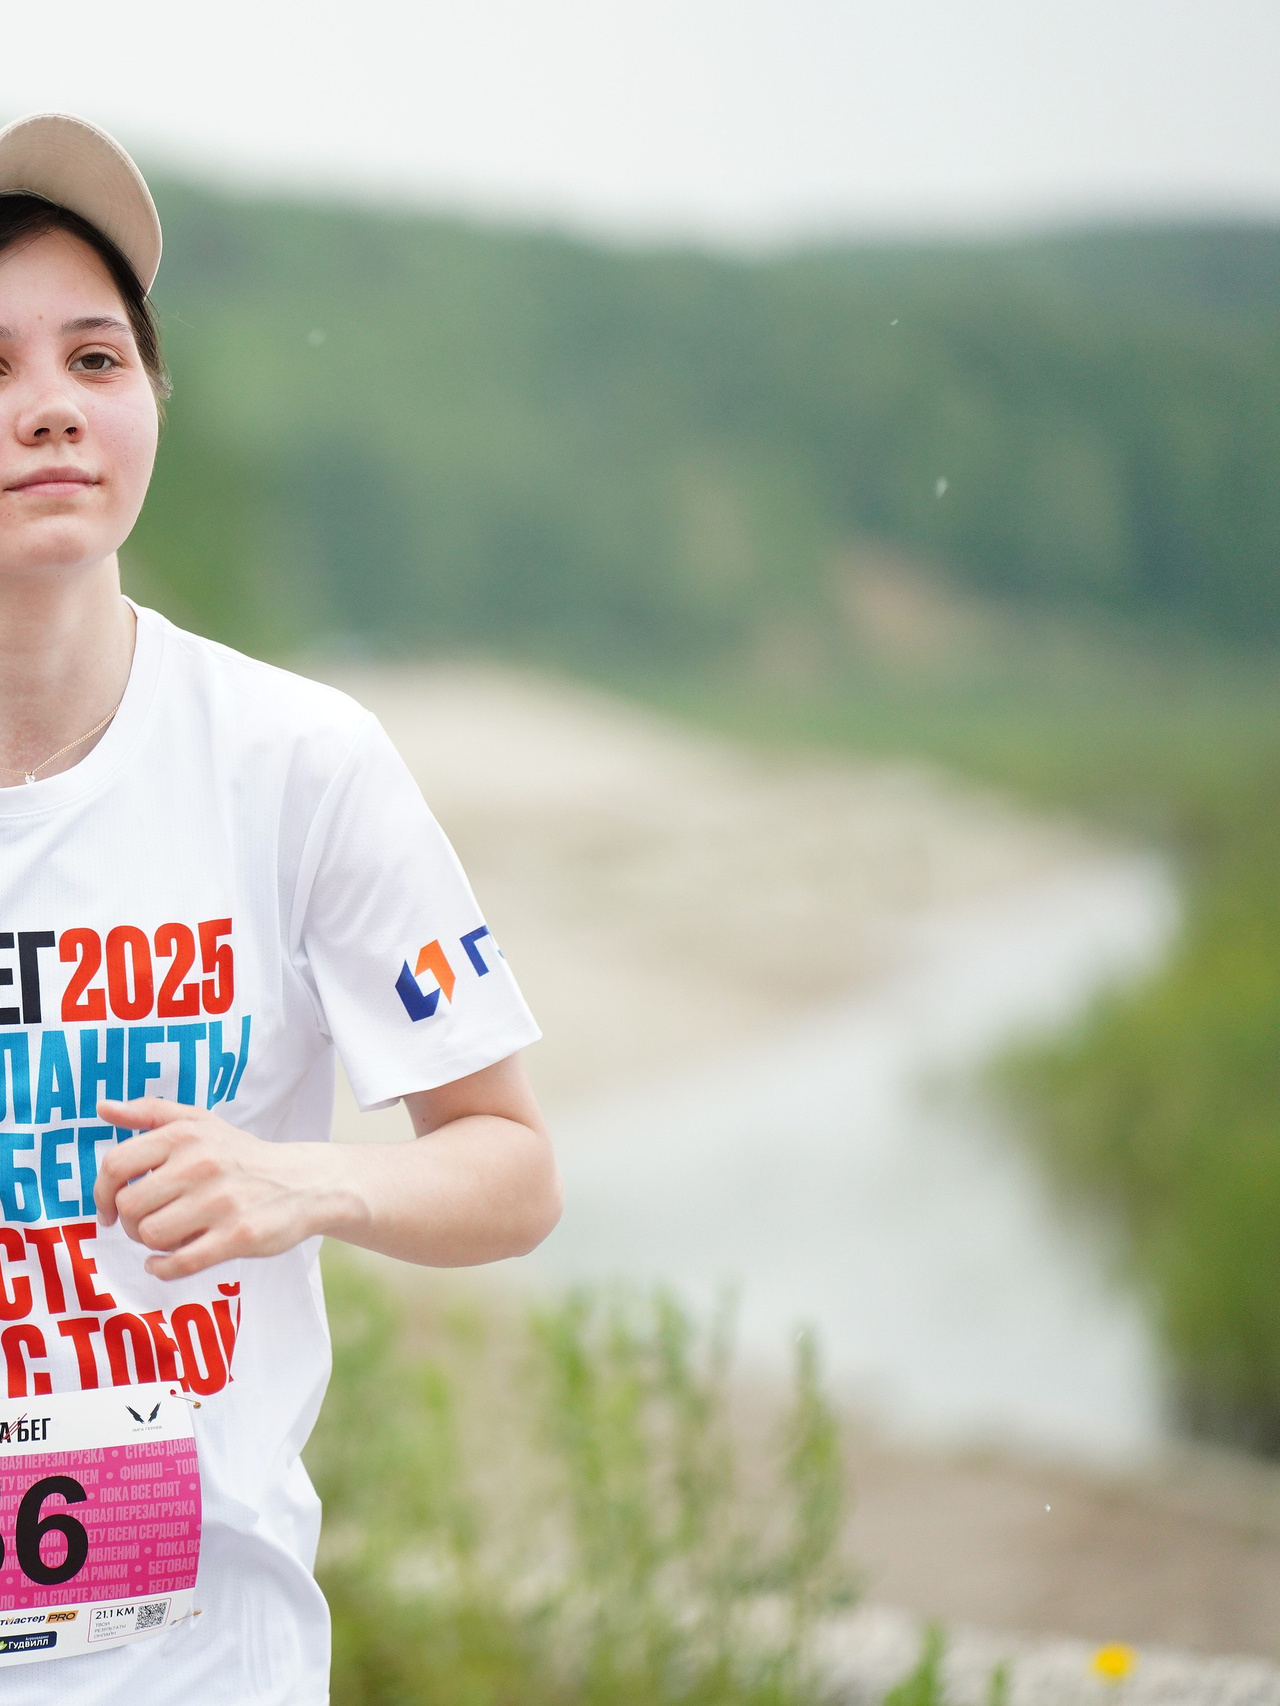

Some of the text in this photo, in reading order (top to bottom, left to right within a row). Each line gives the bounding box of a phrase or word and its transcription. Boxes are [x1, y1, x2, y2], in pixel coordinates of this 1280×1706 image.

[1, 1324, 53, 1398] С
[25, 1448, 105, 1469] ПЕРЕЗАГРУЗКА
[125, 1442, 165, 1459] СТРЕСС
[120, 1462, 163, 1481] ФИНИШ
[100, 1485, 130, 1503] ПОКА
[130, 1483, 152, 1501] ВСЕ
[153, 1480, 181, 1499] СПЯТ
[115, 1500, 196, 1521] ПЕРЕЗАГРУЗКА
[107, 1525, 138, 1543] ВСЕМ
[138, 1521, 190, 1540] СЕРДЦЕМ
[156, 1540, 185, 1557] ПОКА
[90, 1563, 128, 1581] РАМКИ
[148, 1556, 196, 1575] БЕГОВАЯ
[33, 1591, 48, 1607] НА
[48, 1587, 89, 1605] СТАРТЕ
[89, 1583, 131, 1601] ЖИЗНИ
[148, 1577, 174, 1594] БЕГУ
[47, 1611, 76, 1623] PRO
[95, 1609, 114, 1619] 21.1
